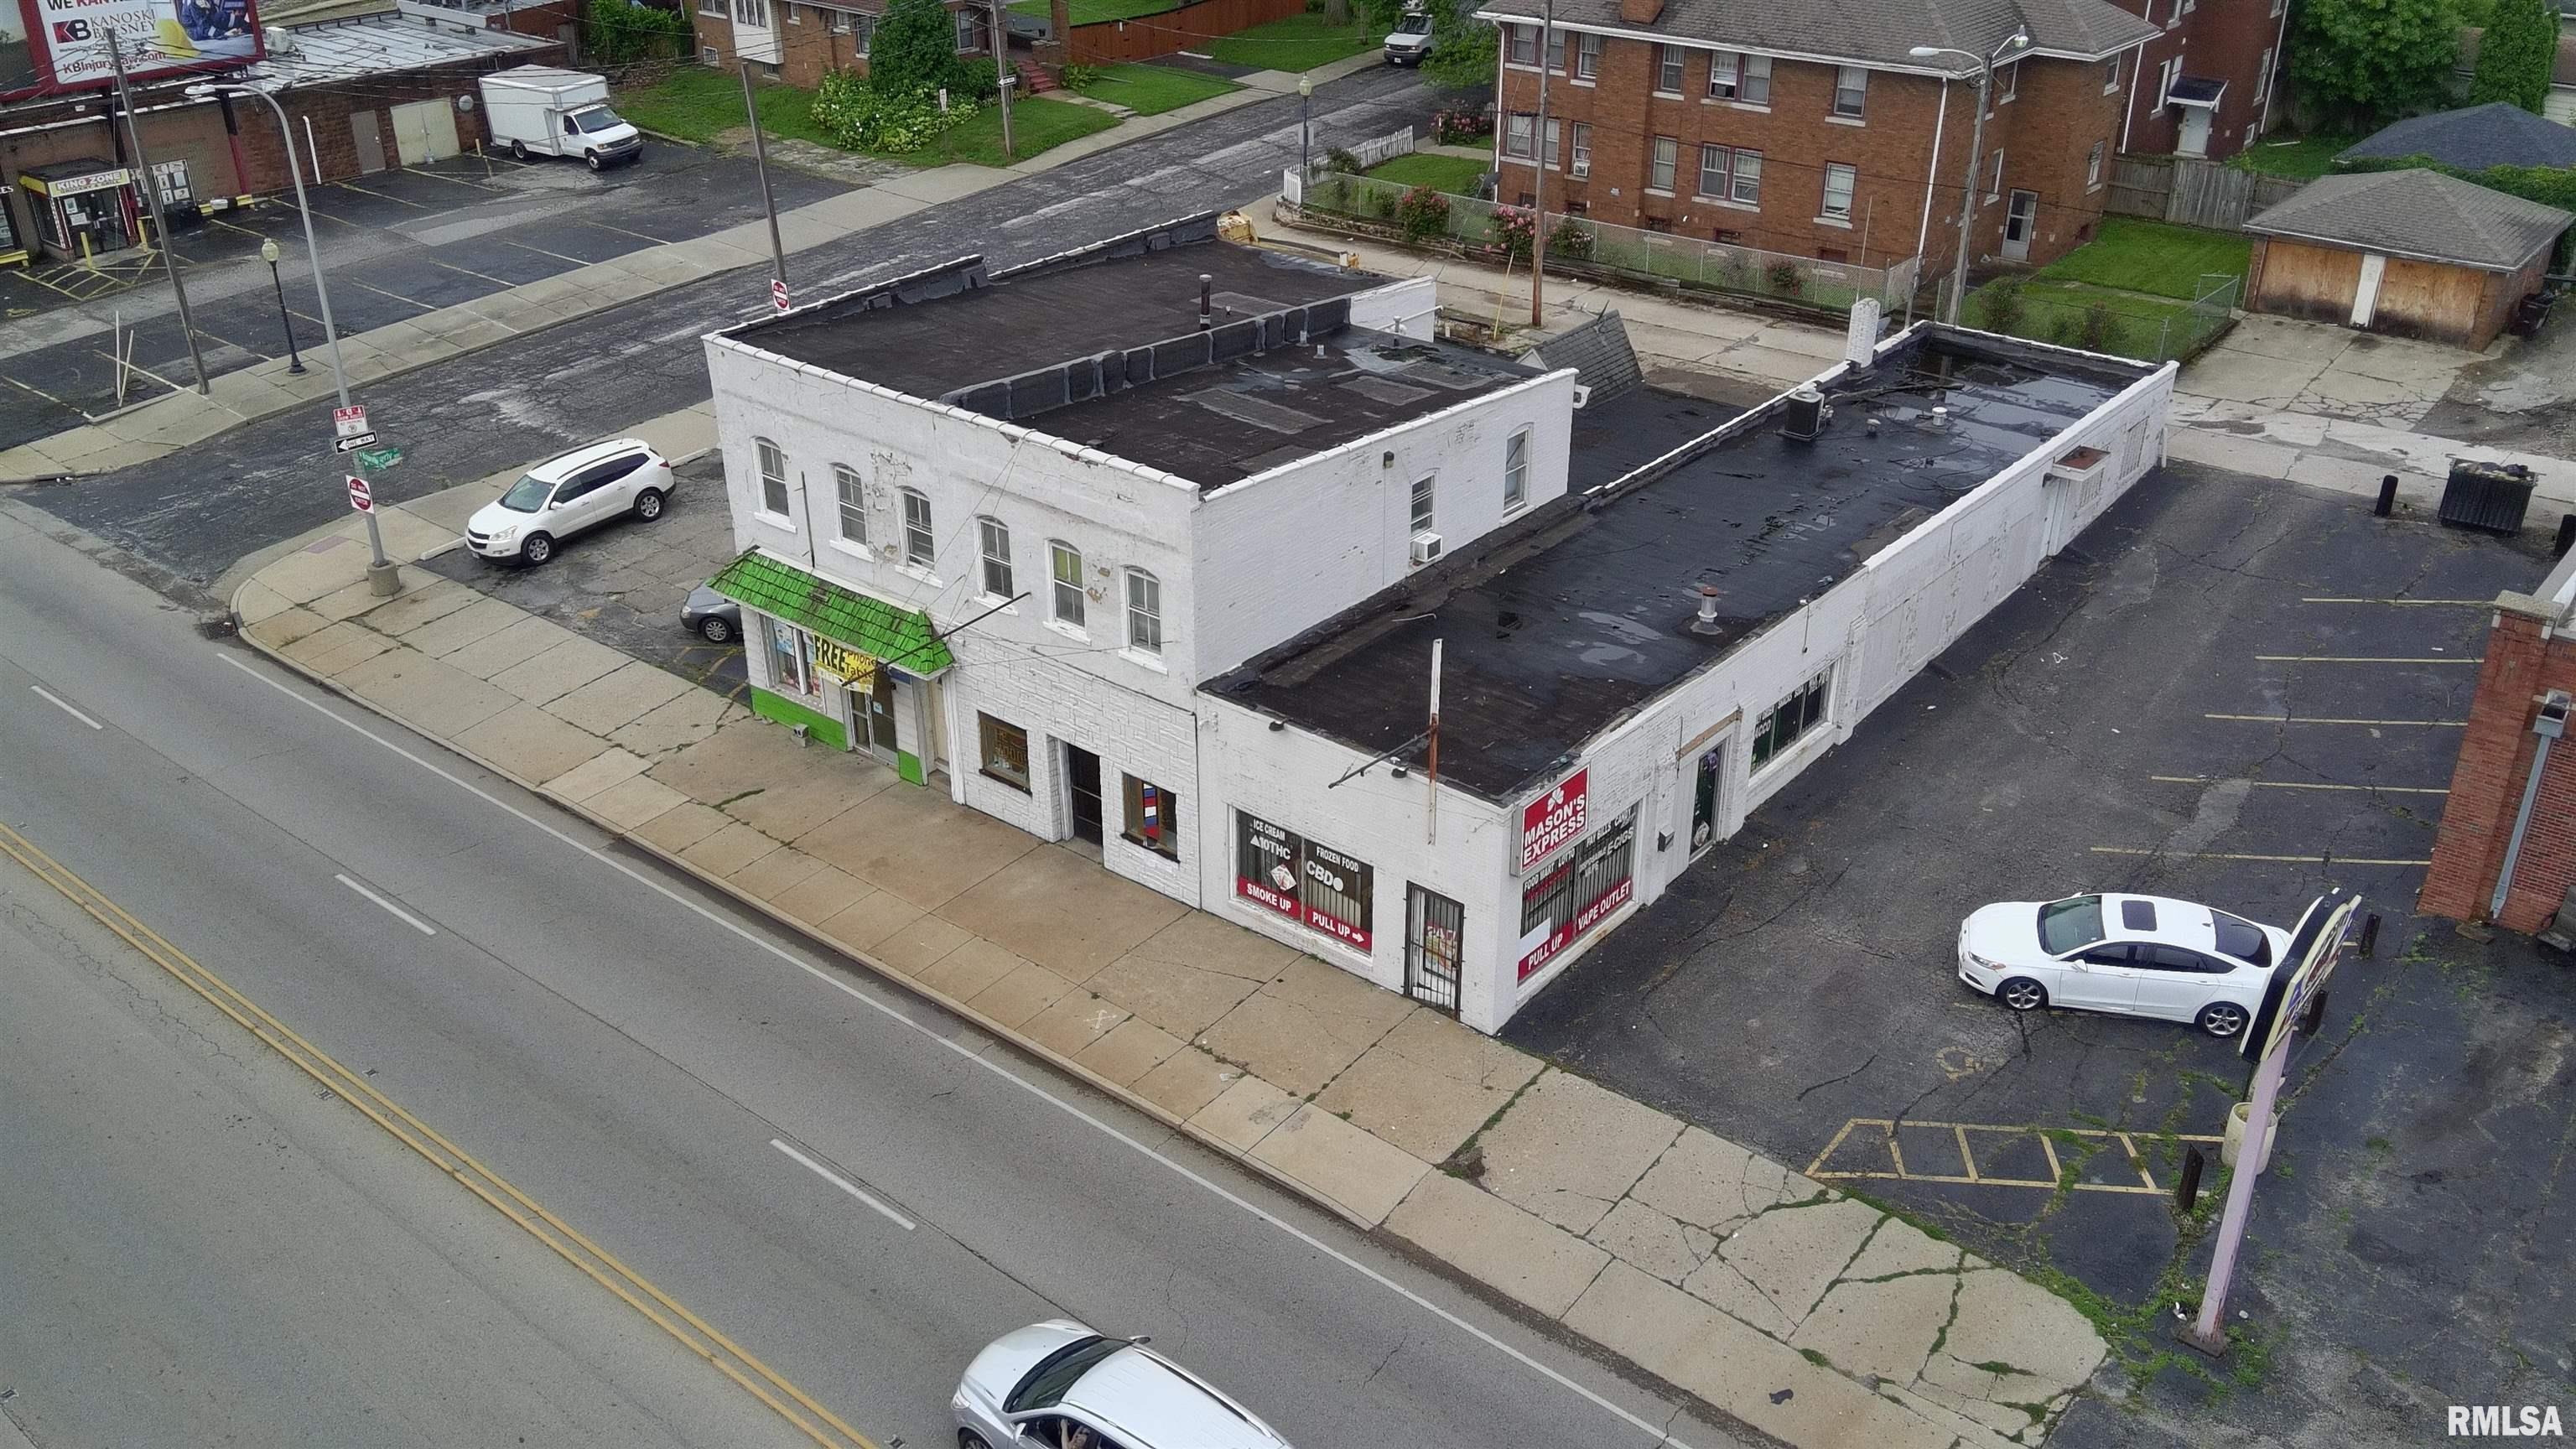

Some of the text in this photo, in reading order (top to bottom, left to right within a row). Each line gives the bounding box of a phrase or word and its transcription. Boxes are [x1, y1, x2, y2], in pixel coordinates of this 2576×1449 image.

[90, 8, 156, 28] KANOSKI
[56, 171, 122, 190] KING ZONE
[345, 439, 357, 447] ONE
[813, 635, 846, 673] FREE
[847, 651, 876, 667] Phone
[1253, 818, 1285, 841] ICE CREAM
[1524, 793, 1585, 848] MASON'S
[1597, 823, 1612, 840] BILLS
[1523, 811, 1585, 865] EXPRESS
[1317, 846, 1359, 873] FROZEN FOOD
[1524, 874, 1540, 893] FOOD
[1540, 862, 1555, 880] MART
[1558, 847, 1576, 868] LOTTO
[1247, 883, 1292, 911] SMOKE UP
[1577, 904, 1598, 932] VAPE
[1600, 880, 1631, 913] OUTLET
[1312, 911, 1351, 937] PULL UP
[1527, 932, 1564, 971] PULL UP
